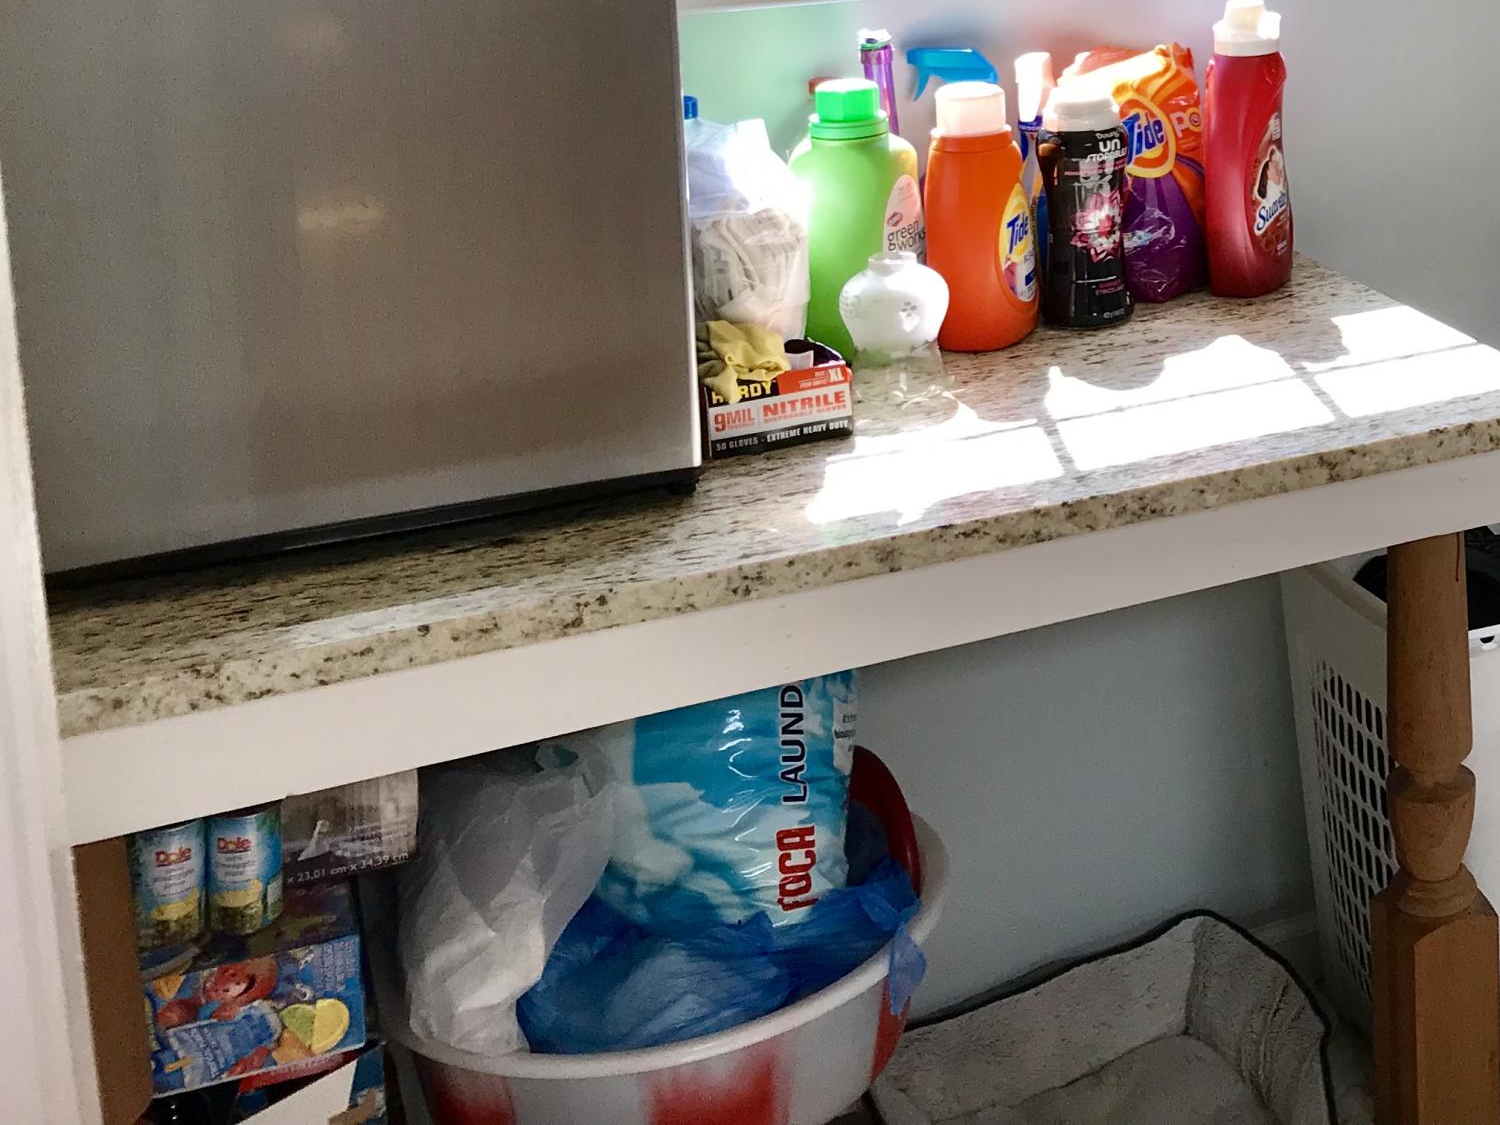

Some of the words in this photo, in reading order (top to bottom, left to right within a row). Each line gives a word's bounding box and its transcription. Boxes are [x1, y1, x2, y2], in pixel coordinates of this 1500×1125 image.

[1168, 106, 1201, 139] PO
[1121, 111, 1165, 167] Tide
[887, 220, 919, 252] green
[1007, 210, 1029, 255] Tide
[828, 368, 845, 382] XL
[711, 381, 774, 404] HRDY
[763, 391, 846, 417] NITRILE
[729, 437, 759, 450] GLOVES
[766, 429, 801, 443] EXTREME
[803, 423, 827, 435] HEAVY
[829, 419, 849, 431] DUTY
[779, 684, 809, 806] LAUND
[155, 846, 193, 866] Dole
[216, 837, 252, 853] Dole
[297, 869, 325, 882] 23.01
[330, 866, 347, 875] cm
[360, 855, 390, 870] 34.39
[392, 853, 409, 862] cm
